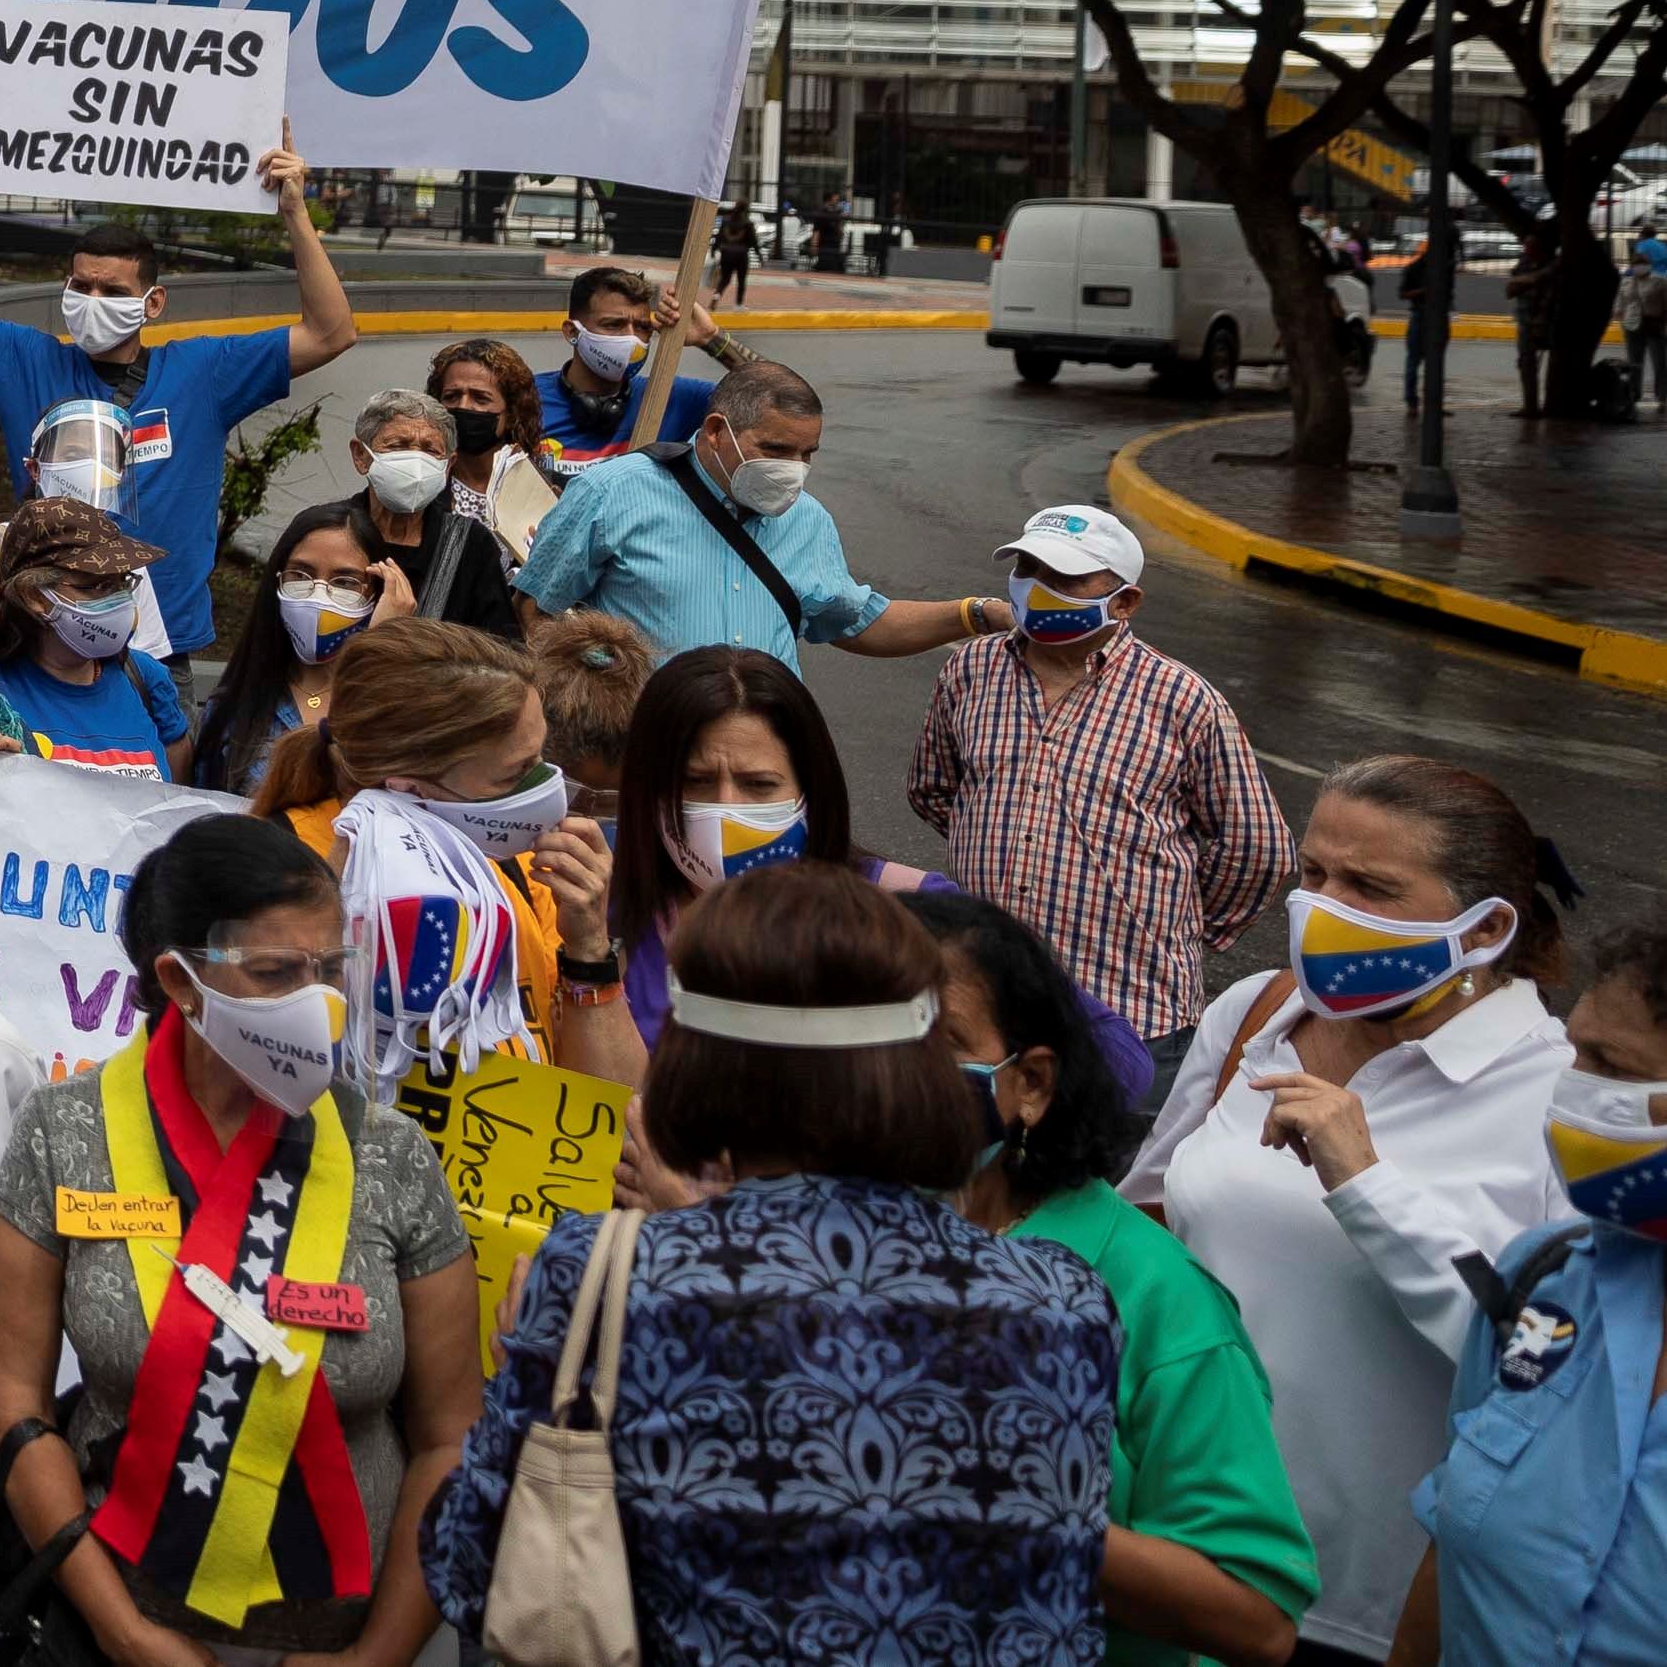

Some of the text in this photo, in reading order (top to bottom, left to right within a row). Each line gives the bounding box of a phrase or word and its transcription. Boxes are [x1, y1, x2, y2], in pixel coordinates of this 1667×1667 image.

[67, 76, 178, 128] SIN
[588, 344, 623, 369] VACUNAS
[595, 359, 610, 372] YA
[70, 612, 118, 640] VACUNAS
[81, 628, 96, 644] YA
[461, 812, 544, 834] VACUNAS
[399, 833, 418, 852] YA
[485, 830, 509, 845] YA
[238, 1028, 329, 1067] VACUNAS
[267, 1054, 299, 1080] YA
[123, 1198, 175, 1213] entrar
[86, 1216, 102, 1231] la
[278, 1283, 350, 1302] Es un
[268, 1298, 366, 1327] derecho
